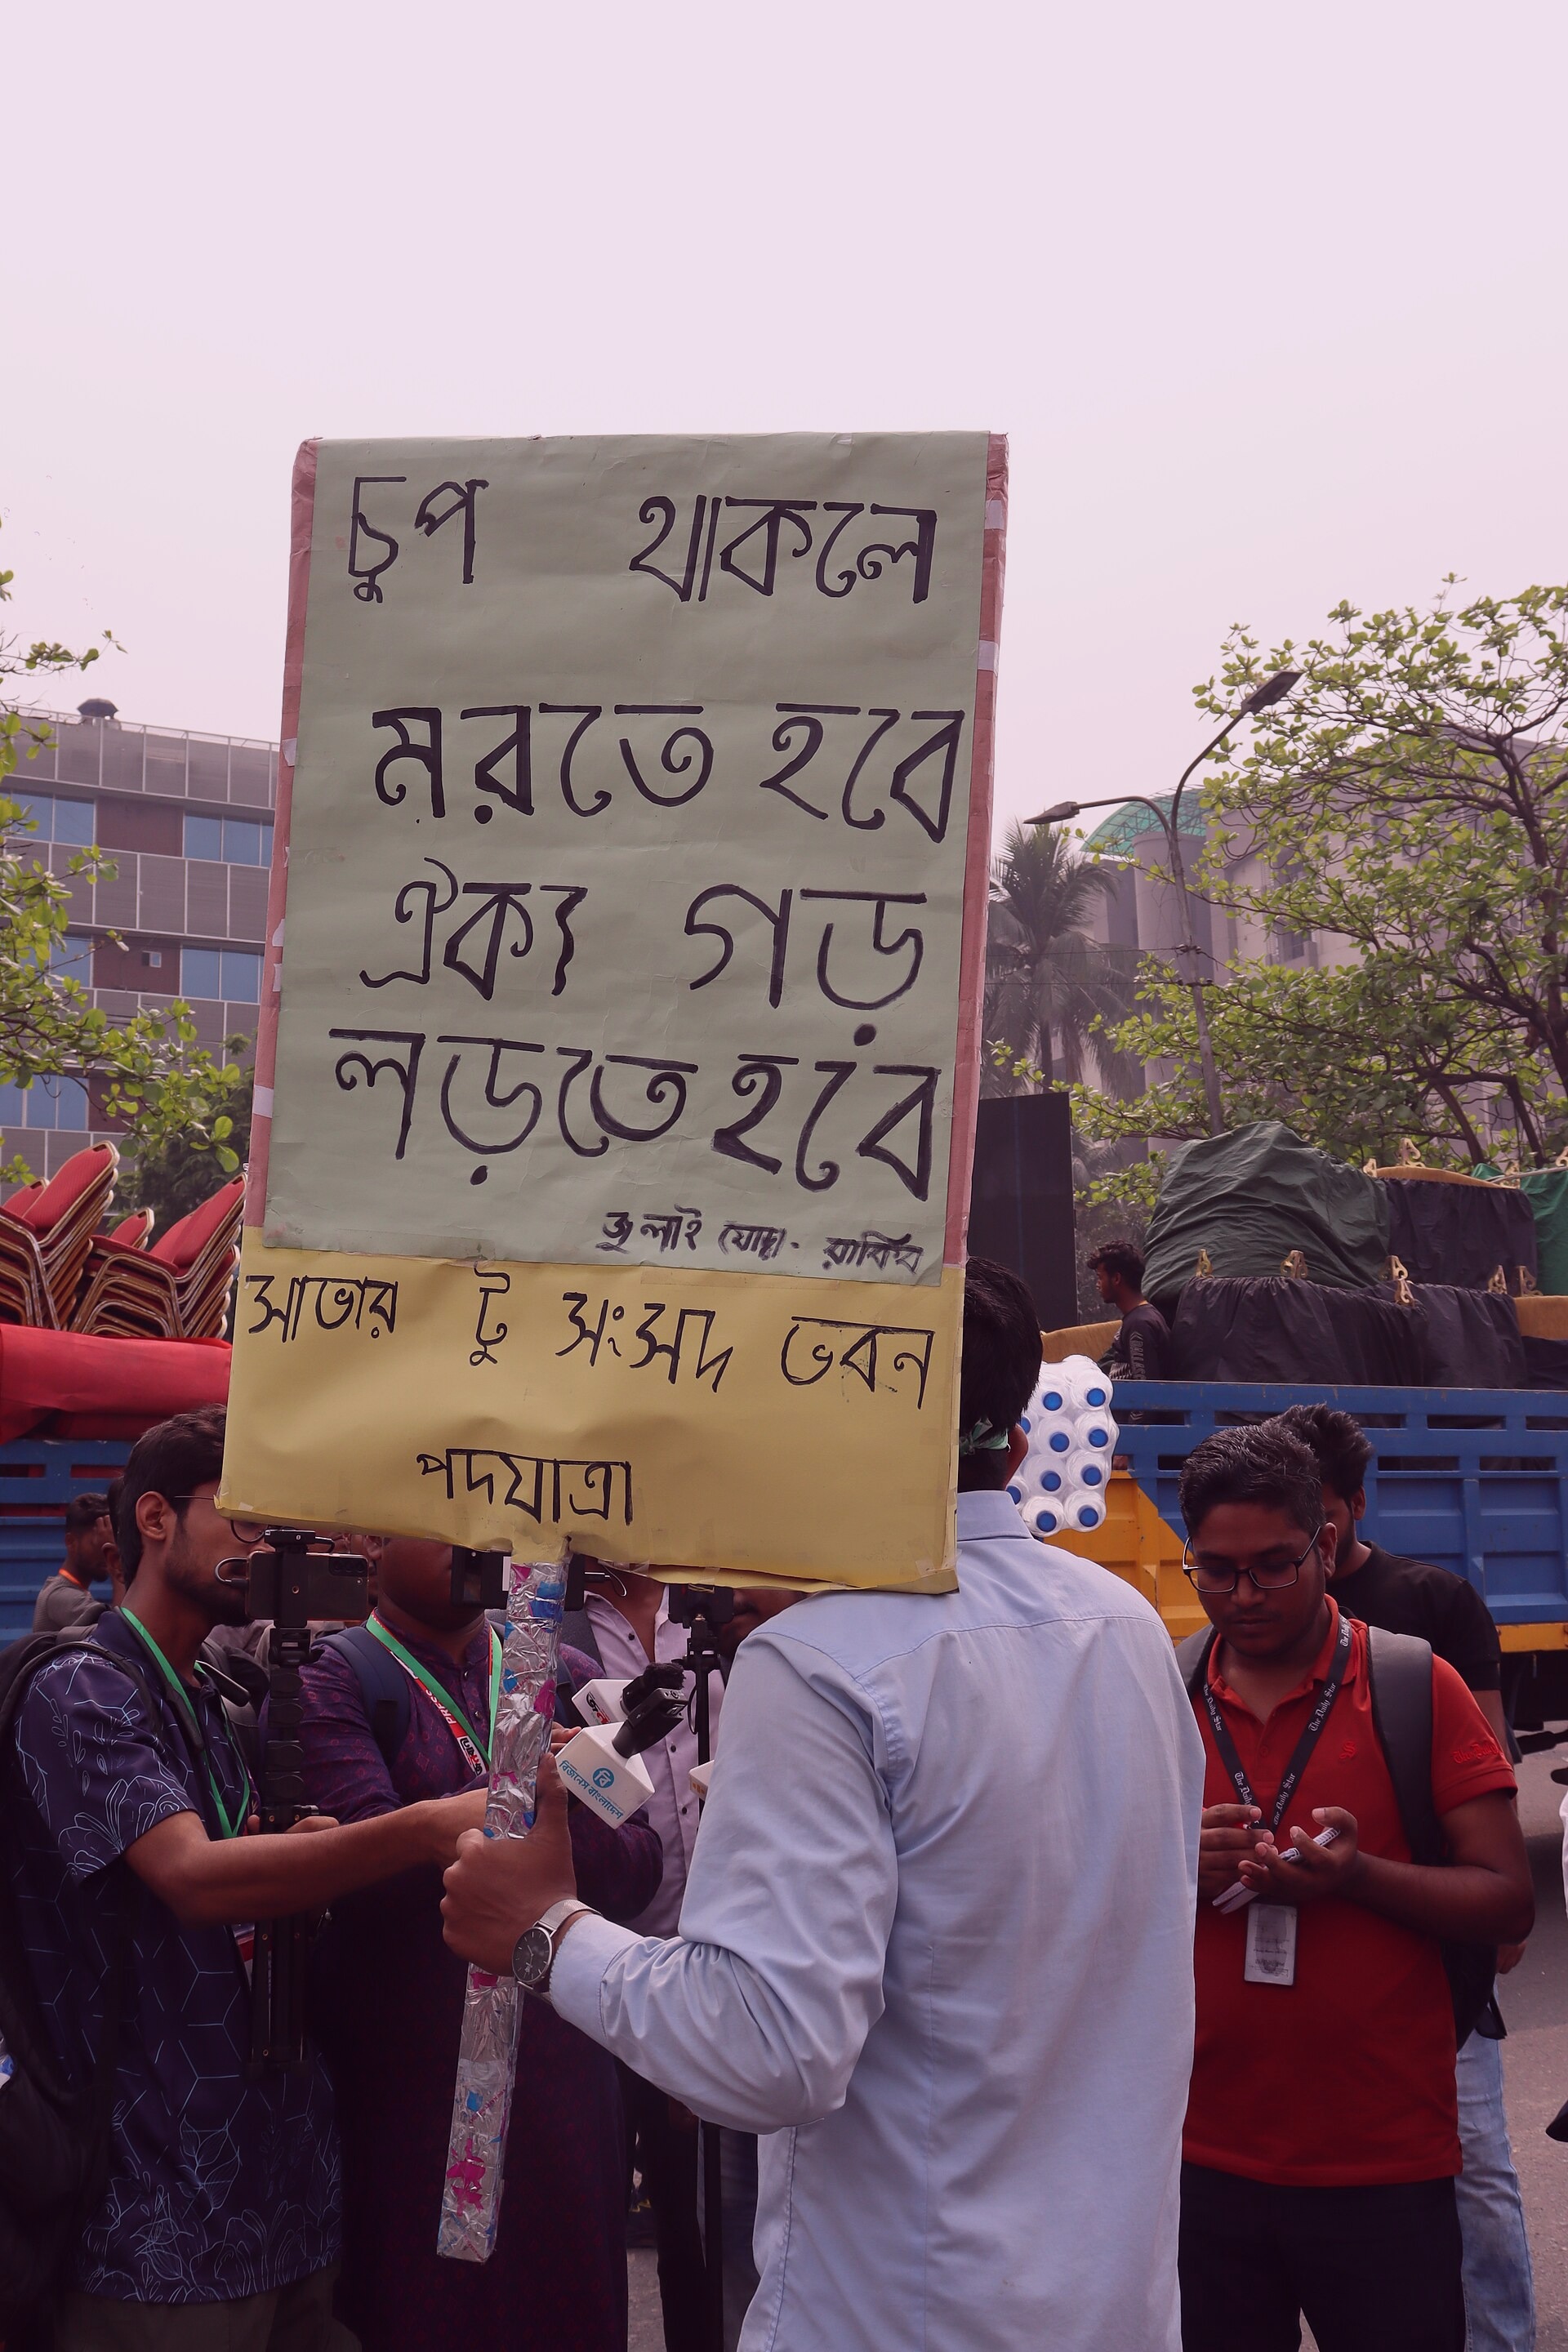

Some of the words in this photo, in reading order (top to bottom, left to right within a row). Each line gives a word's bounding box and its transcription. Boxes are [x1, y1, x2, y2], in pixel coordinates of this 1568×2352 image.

[349, 476, 489, 604] চুপ
[629, 494, 938, 604] থাকলে
[372, 702, 715, 825] মরতে
[760, 702, 965, 844] হবে
[684, 884, 928, 1047] গড়
[329, 1028, 698, 1186] লড়তে
[711, 1054, 942, 1202] হবে
[595, 1204, 702, 1253] জুলাই
[246, 1275, 398, 1343] সাভার
[470, 1263, 510, 1367] টু
[555, 1291, 733, 1393] সংসদ
[781, 1316, 935, 1410] ভবন
[416, 1448, 633, 1526] পদযাত্রা
[1207, 1696, 1217, 1716] Daily
[1214, 1715, 1223, 1731] Star
[1307, 1718, 1321, 1731] The
[1315, 1699, 1330, 1719] Daily
[1324, 1682, 1336, 1698] Star
[559, 1760, 590, 1789] বিজনেস
[588, 1786, 624, 1820] বাংলাদেশ
[1234, 1771, 1245, 1786] The
[1276, 1791, 1289, 1812] Daily
[1283, 1773, 1296, 1789] Star
